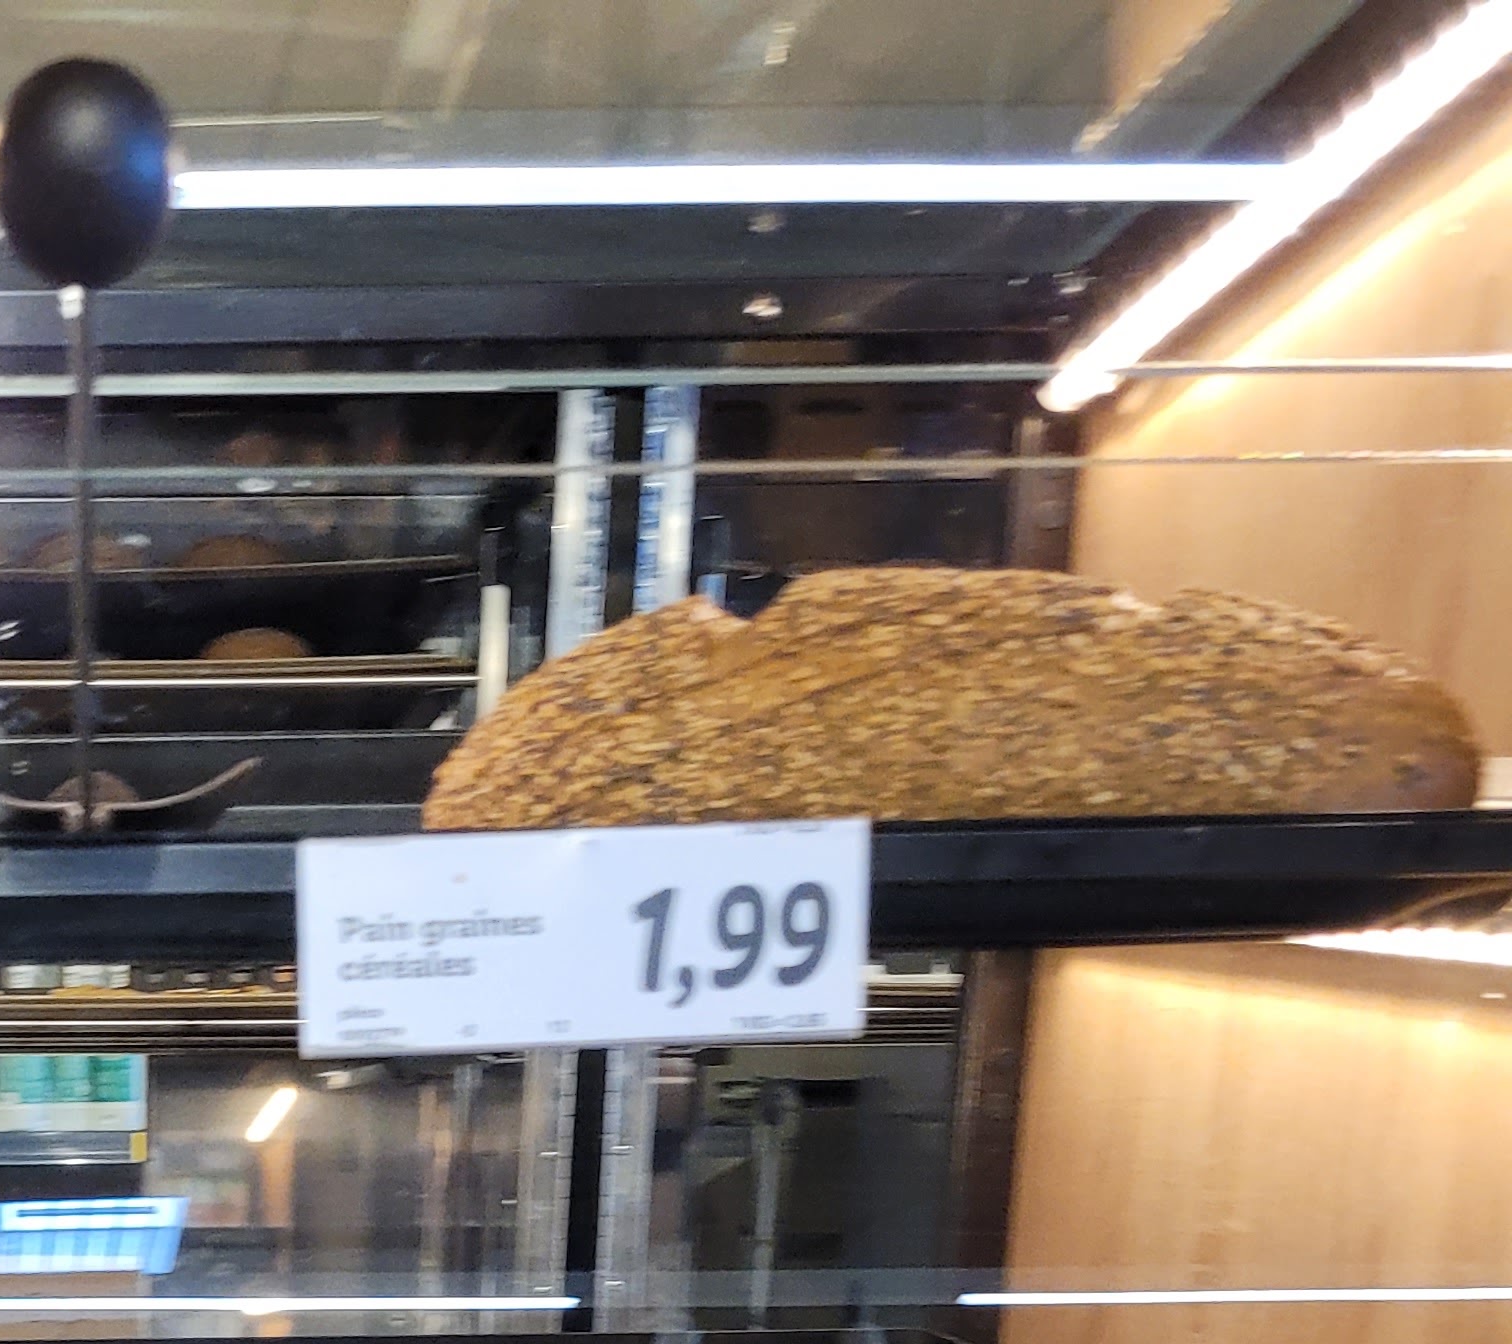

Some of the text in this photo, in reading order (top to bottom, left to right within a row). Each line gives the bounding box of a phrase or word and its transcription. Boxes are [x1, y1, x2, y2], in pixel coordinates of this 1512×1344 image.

[338, 909, 544, 947] Pain graines
[632, 881, 830, 1007] 1,99
[337, 951, 476, 981] céréales
